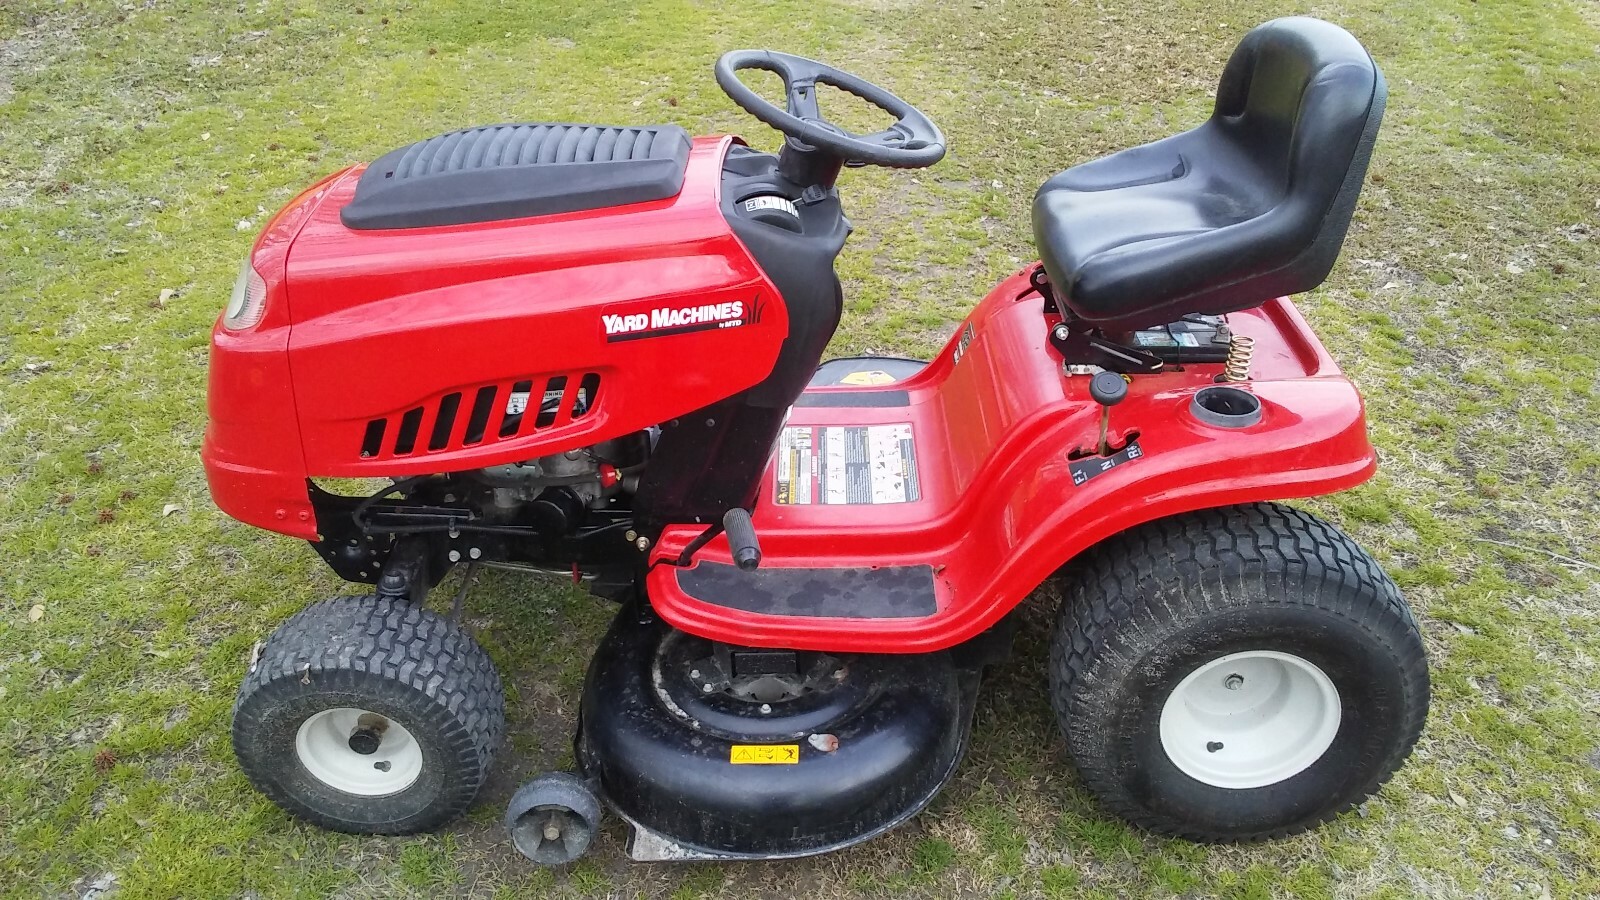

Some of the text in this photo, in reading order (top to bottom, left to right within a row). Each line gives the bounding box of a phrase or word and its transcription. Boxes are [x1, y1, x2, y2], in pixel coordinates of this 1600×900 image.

[602, 301, 743, 334] YARD MACHINES
[1100, 460, 1111, 470] N
